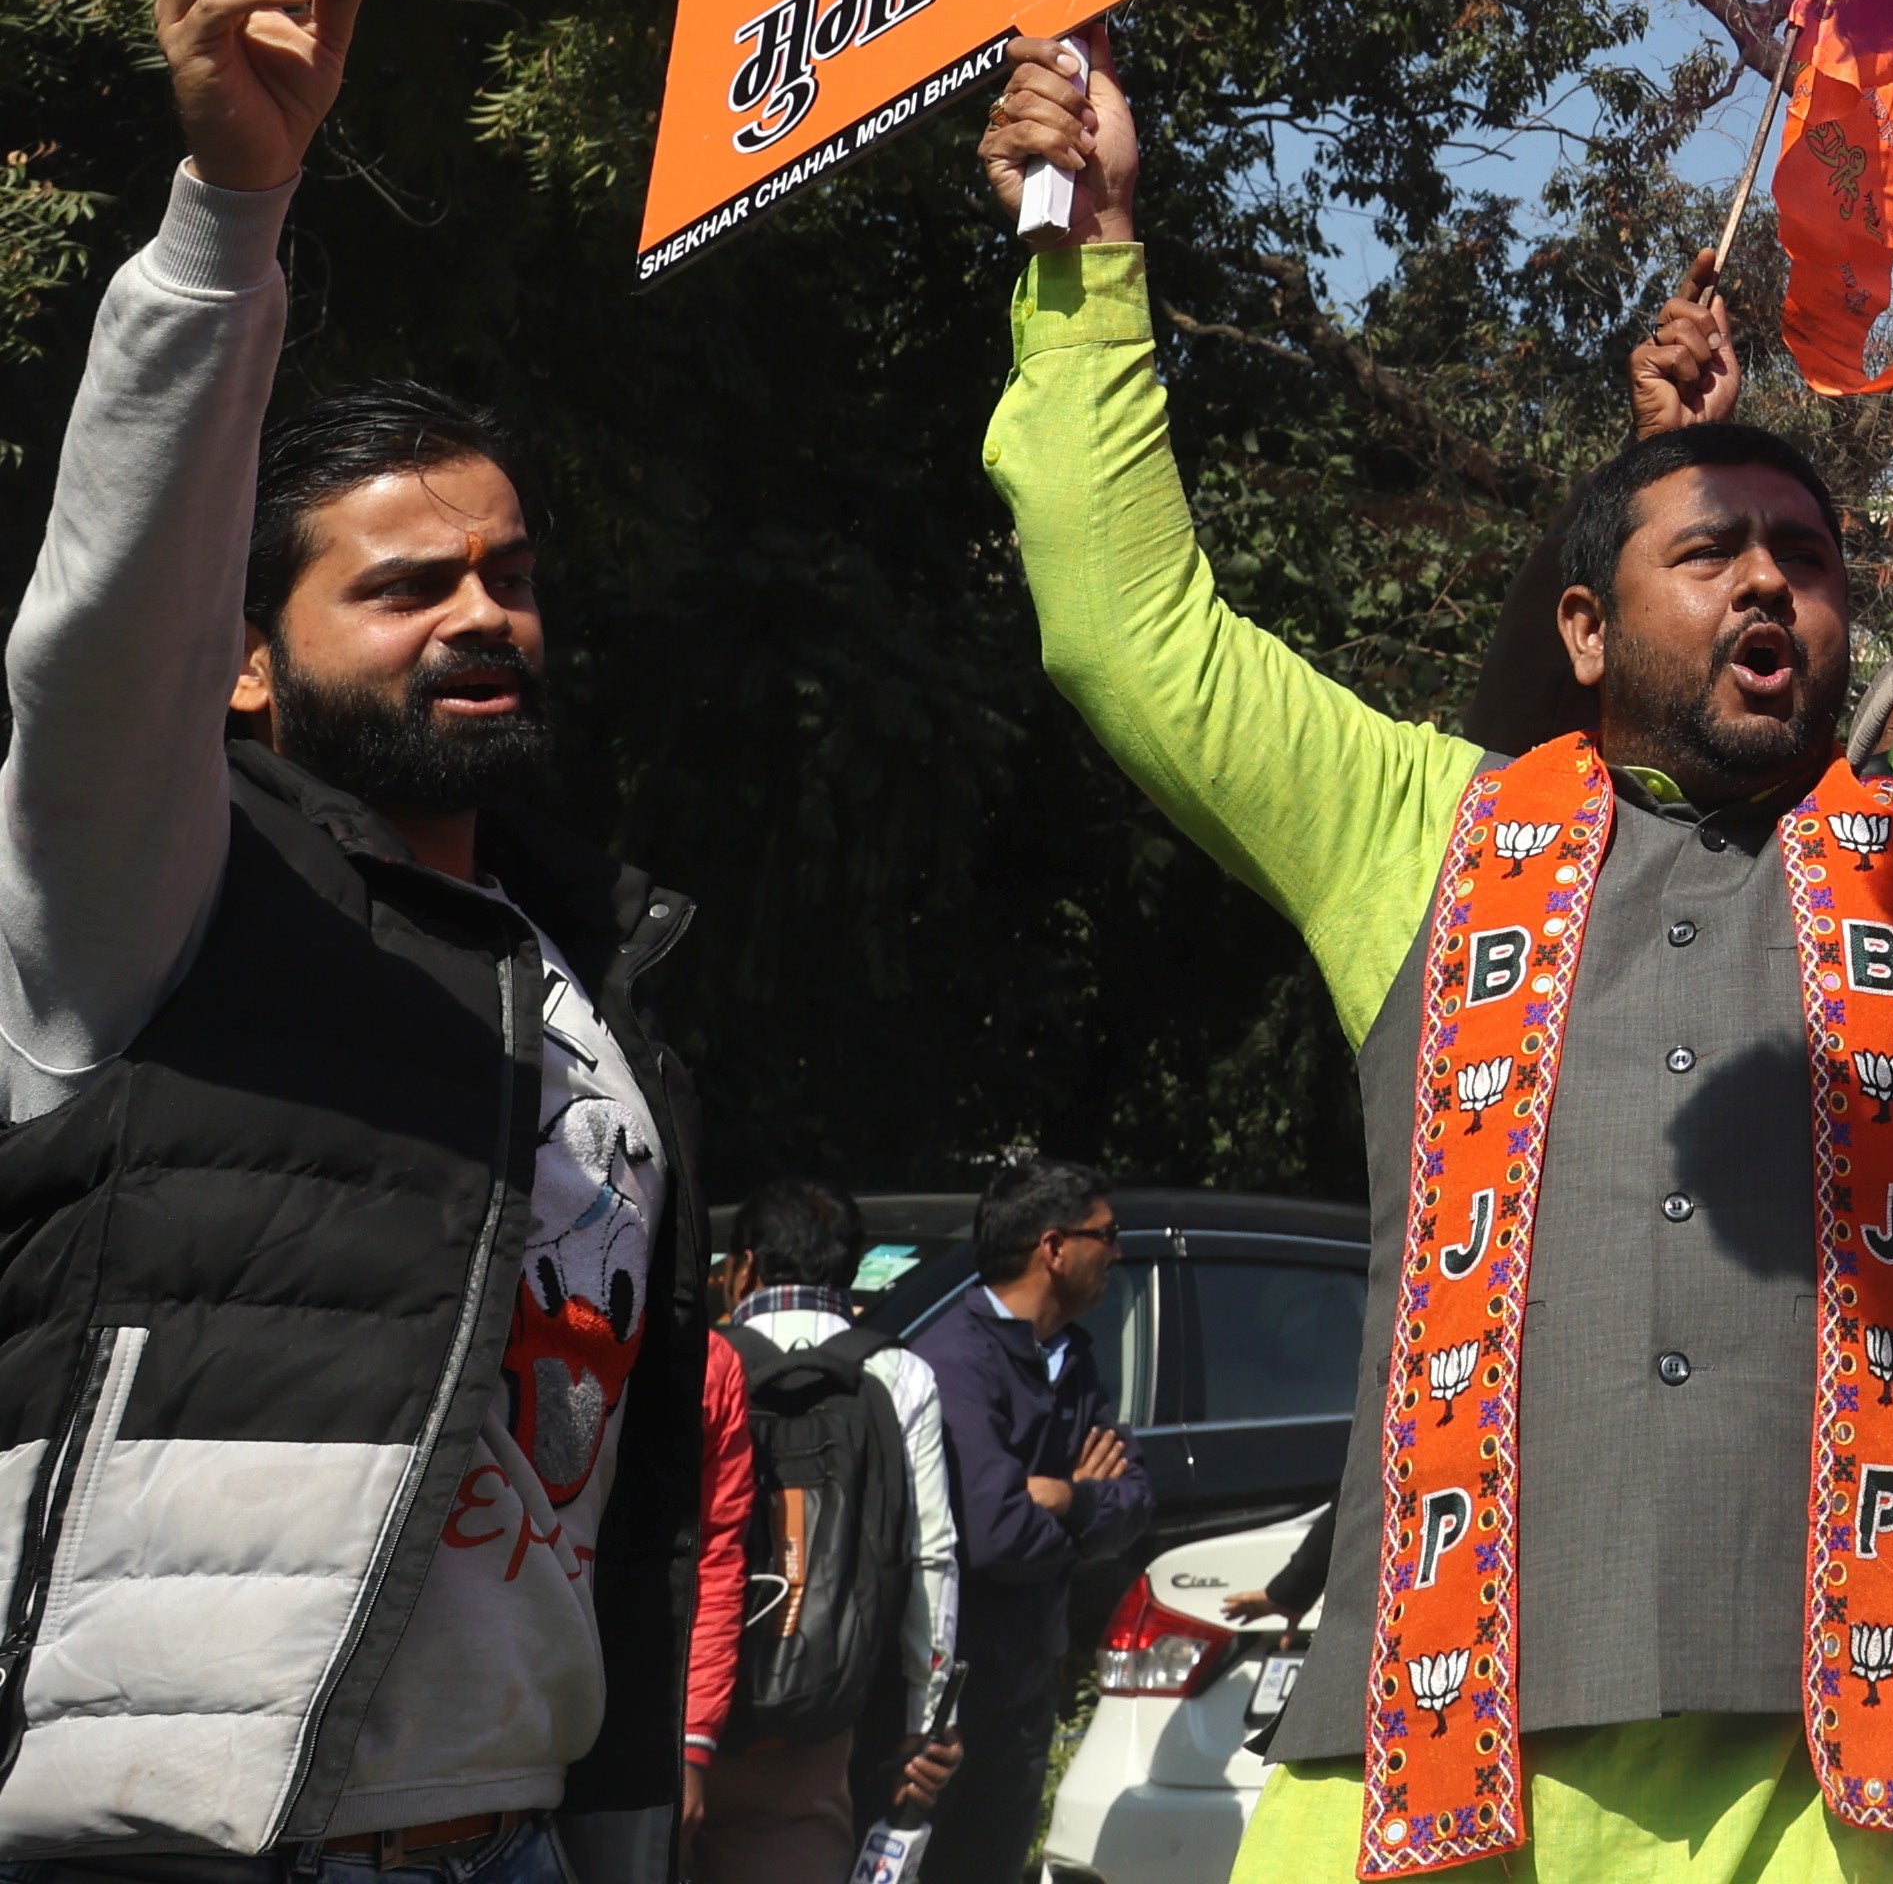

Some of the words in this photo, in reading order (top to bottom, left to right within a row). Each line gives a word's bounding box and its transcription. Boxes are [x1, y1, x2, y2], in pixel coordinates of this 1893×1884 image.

[639, 196, 749, 280] SHEKHAR
[755, 137, 850, 209] CHAHAL
[855, 100, 918, 148] MODI
[923, 37, 1009, 107] BHAKT
[1466, 924, 1533, 1009] B
[1439, 1184, 1495, 1280] J
[1414, 1486, 1472, 1590] P
